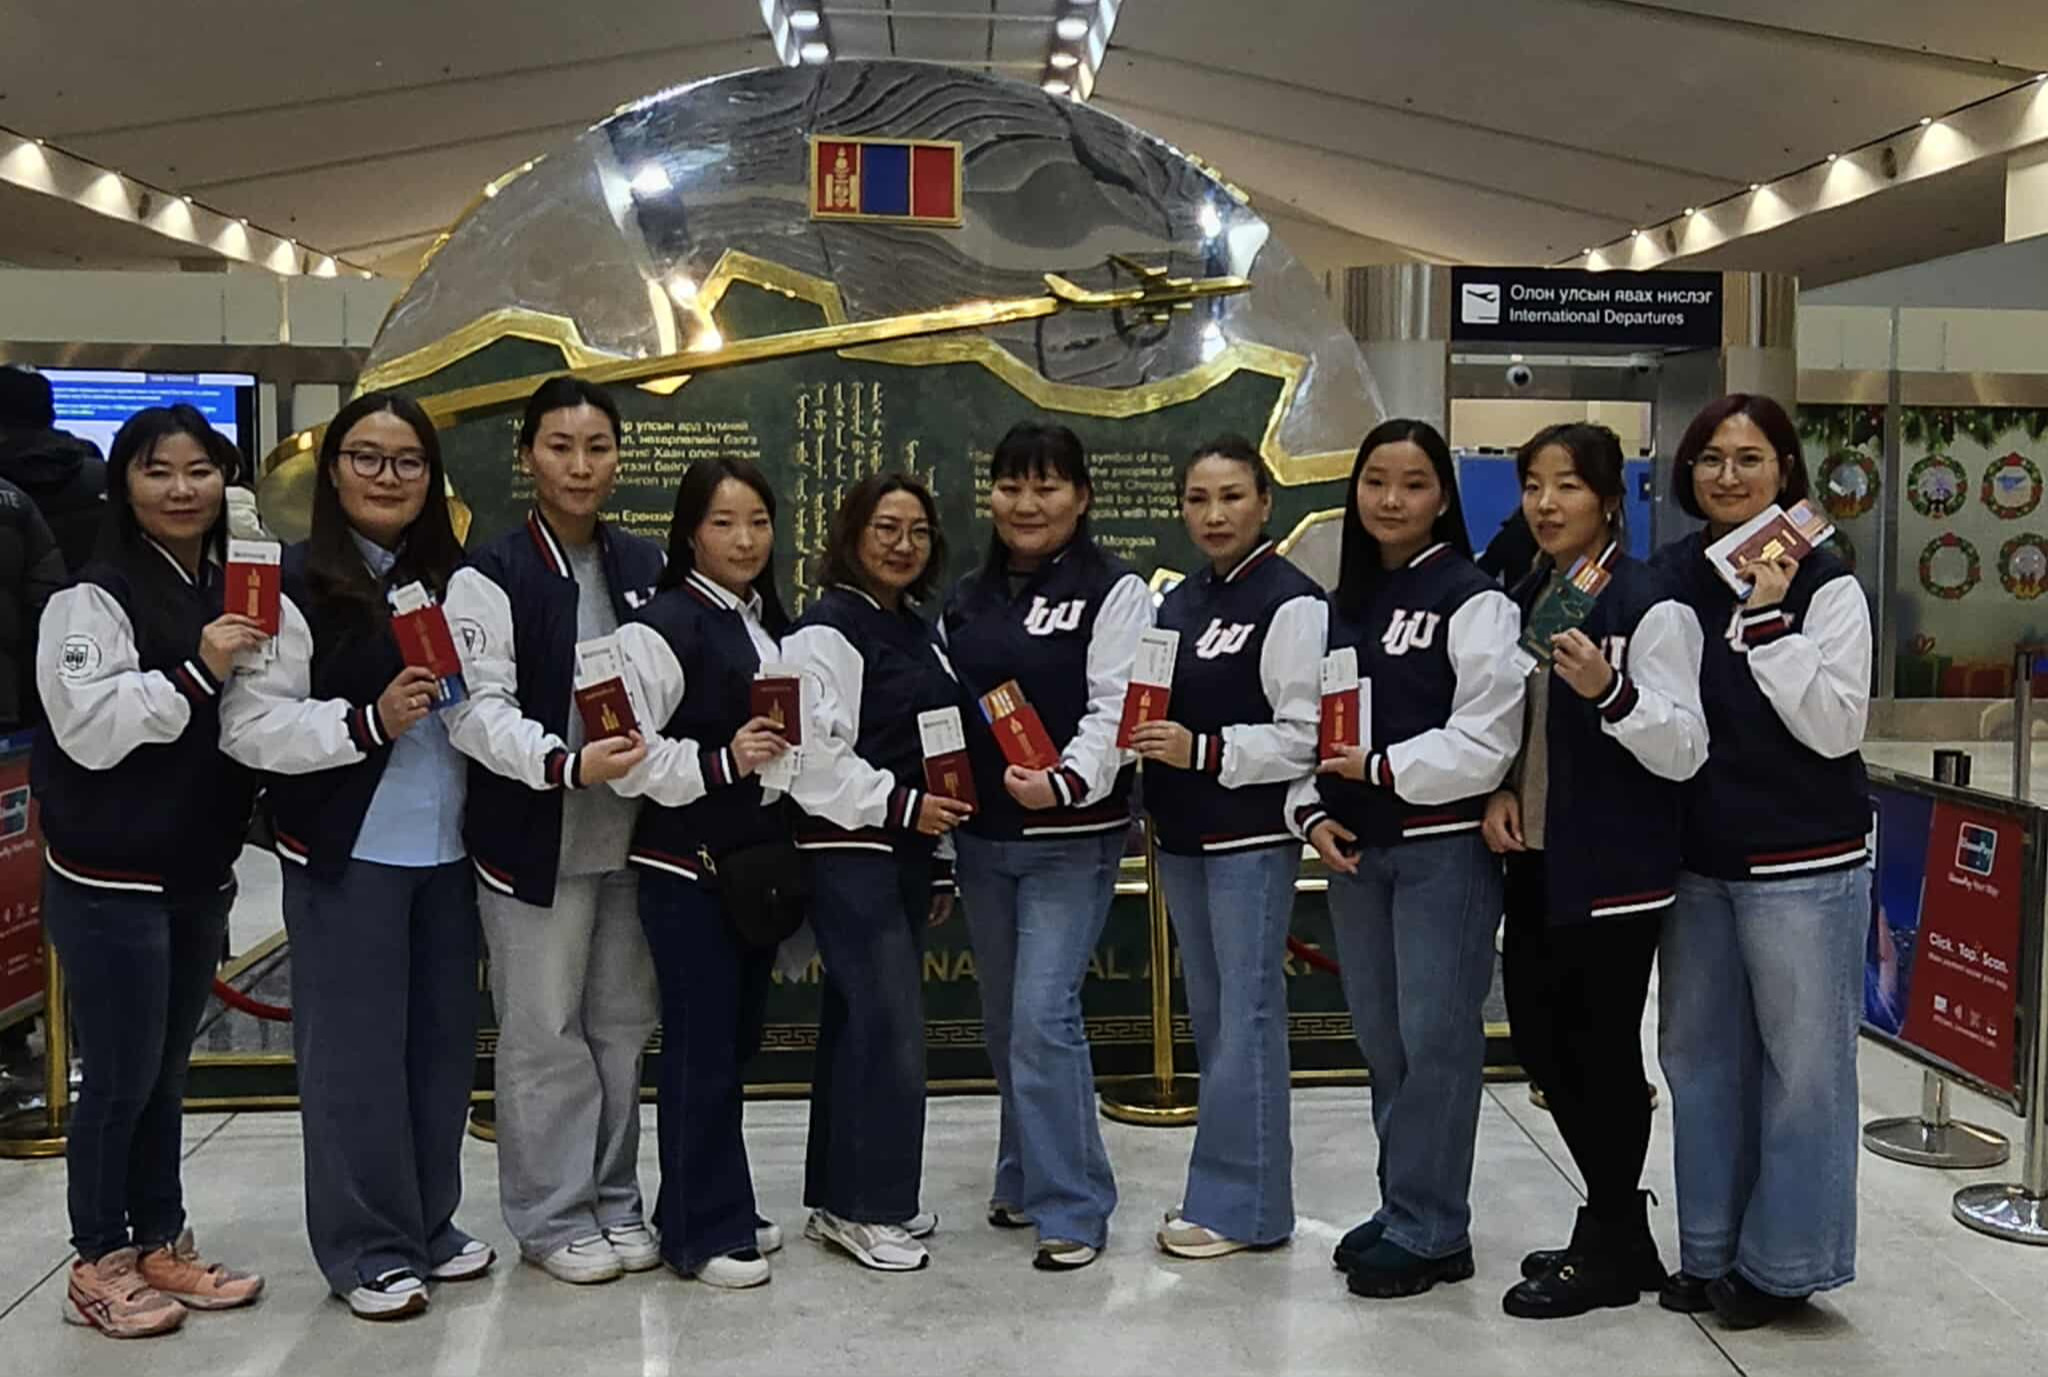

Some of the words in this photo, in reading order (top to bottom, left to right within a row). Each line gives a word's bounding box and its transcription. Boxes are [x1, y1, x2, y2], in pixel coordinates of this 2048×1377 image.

[1510, 283, 1555, 301] Олон
[1559, 287, 1610, 305] улсын
[1614, 288, 1653, 303] явах
[1657, 290, 1713, 304] нислэг
[1509, 307, 1600, 323] International
[1604, 308, 1684, 327] Departures
